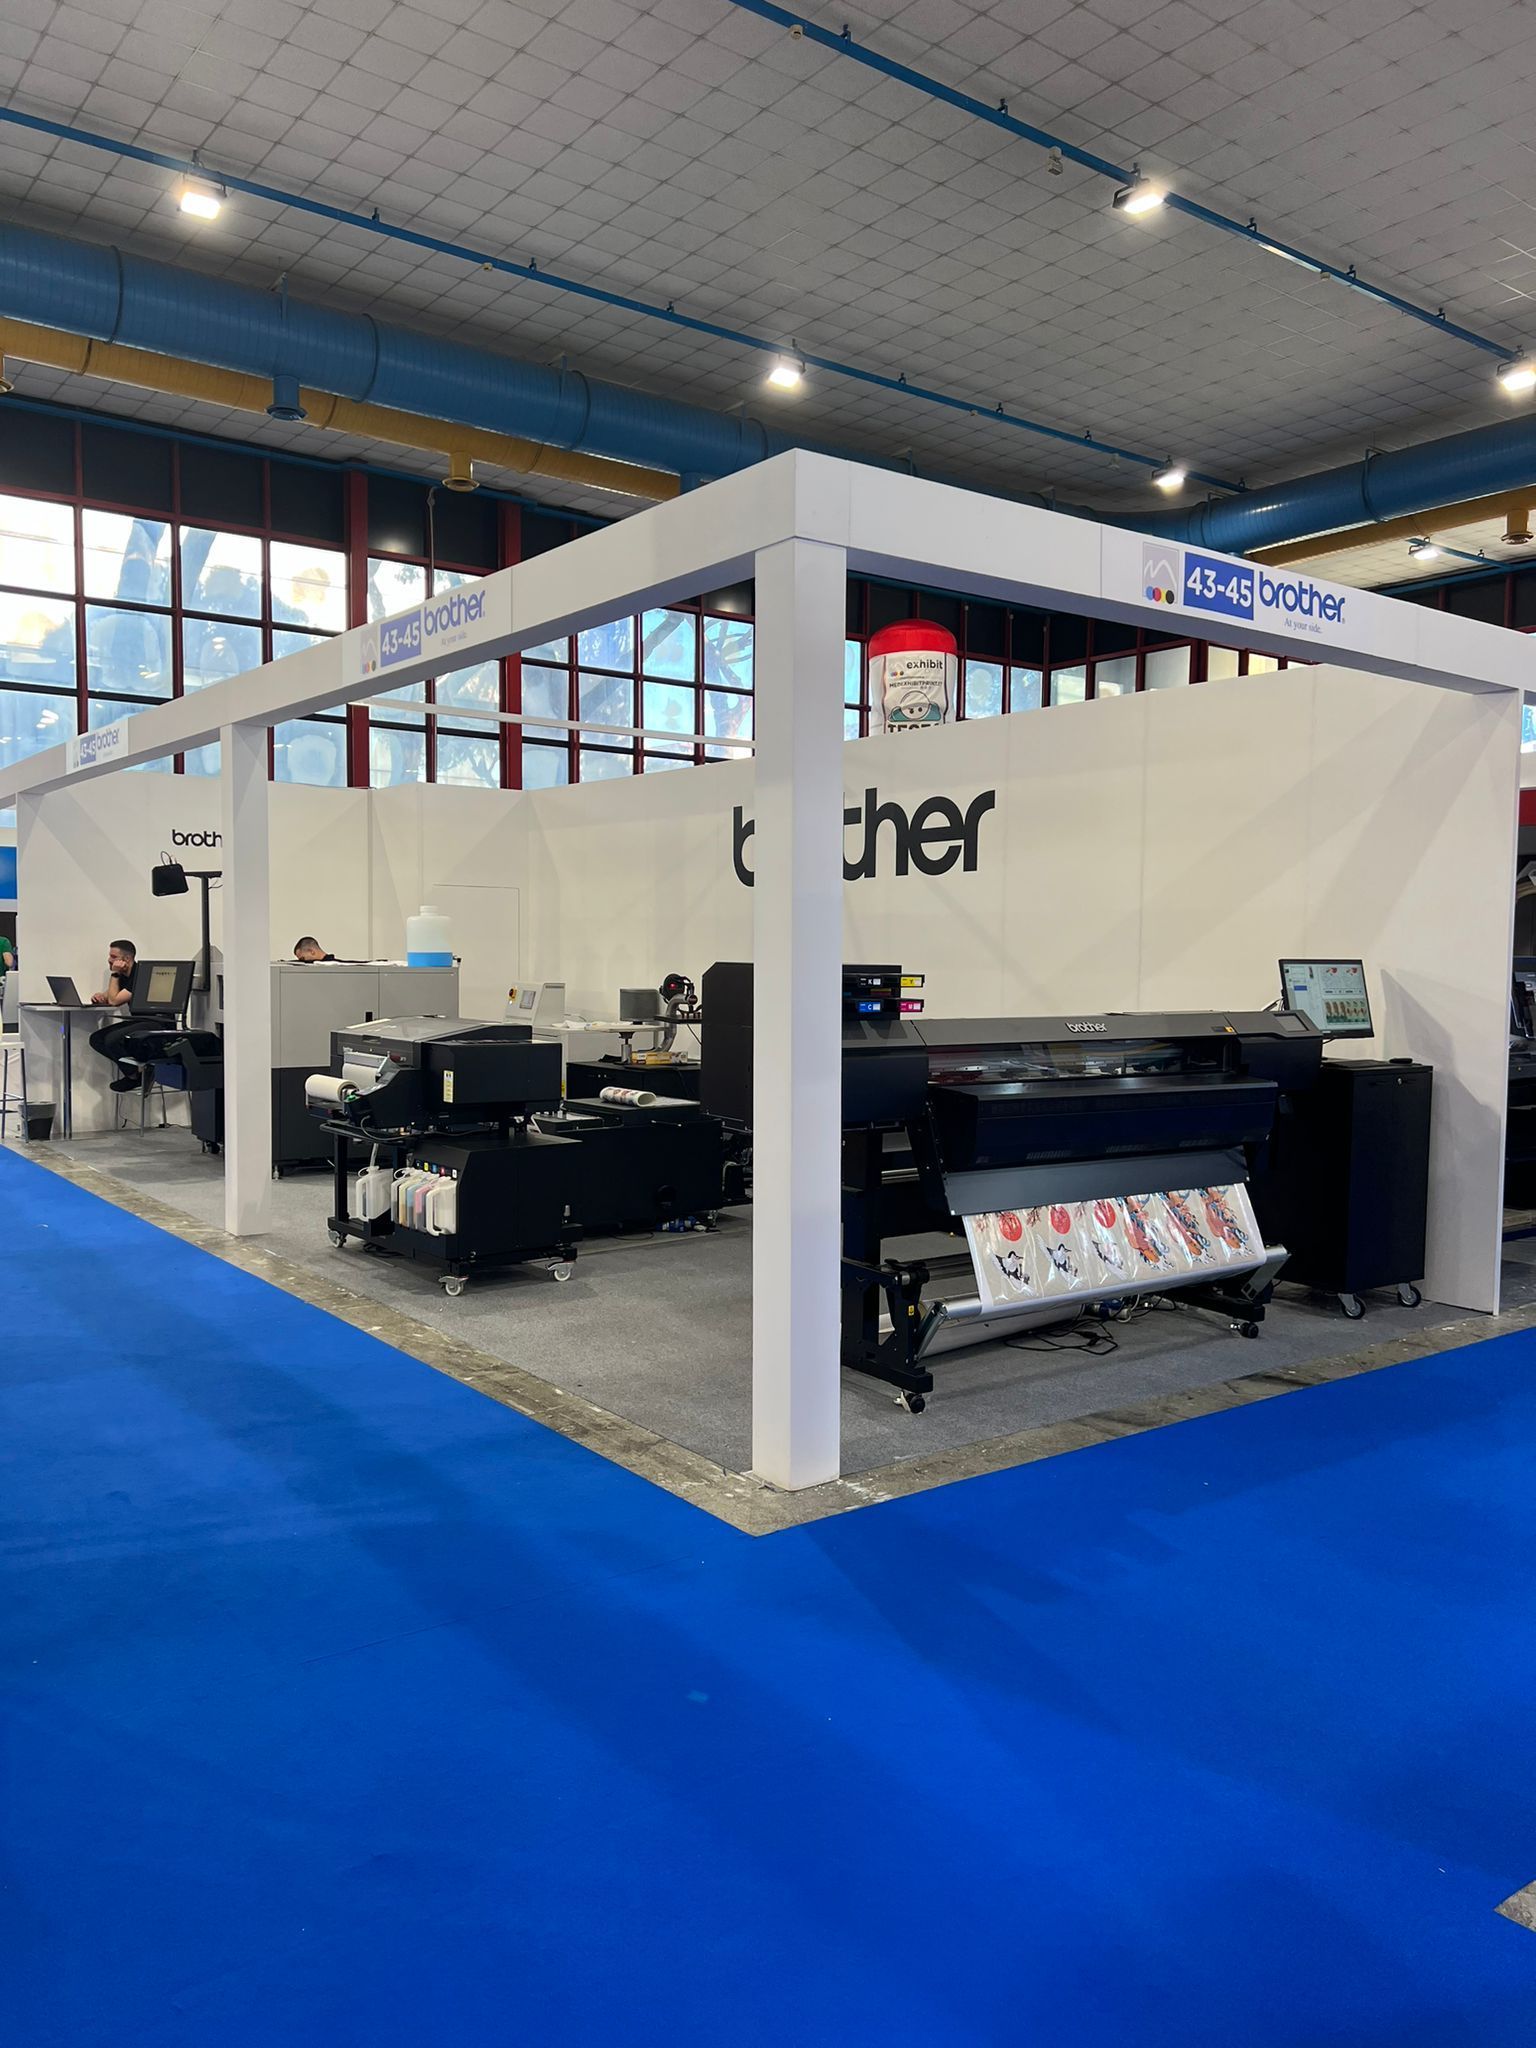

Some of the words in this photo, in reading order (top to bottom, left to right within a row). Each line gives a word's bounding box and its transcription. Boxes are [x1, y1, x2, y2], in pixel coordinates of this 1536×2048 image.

[1187, 567, 1252, 608] 43-45
[1259, 571, 1345, 622] brother
[381, 621, 420, 656] 43-45
[424, 590, 485, 636] brother
[906, 660, 943, 669] exhibit
[172, 829, 222, 848] broth
[1065, 1021, 1107, 1033] brother
